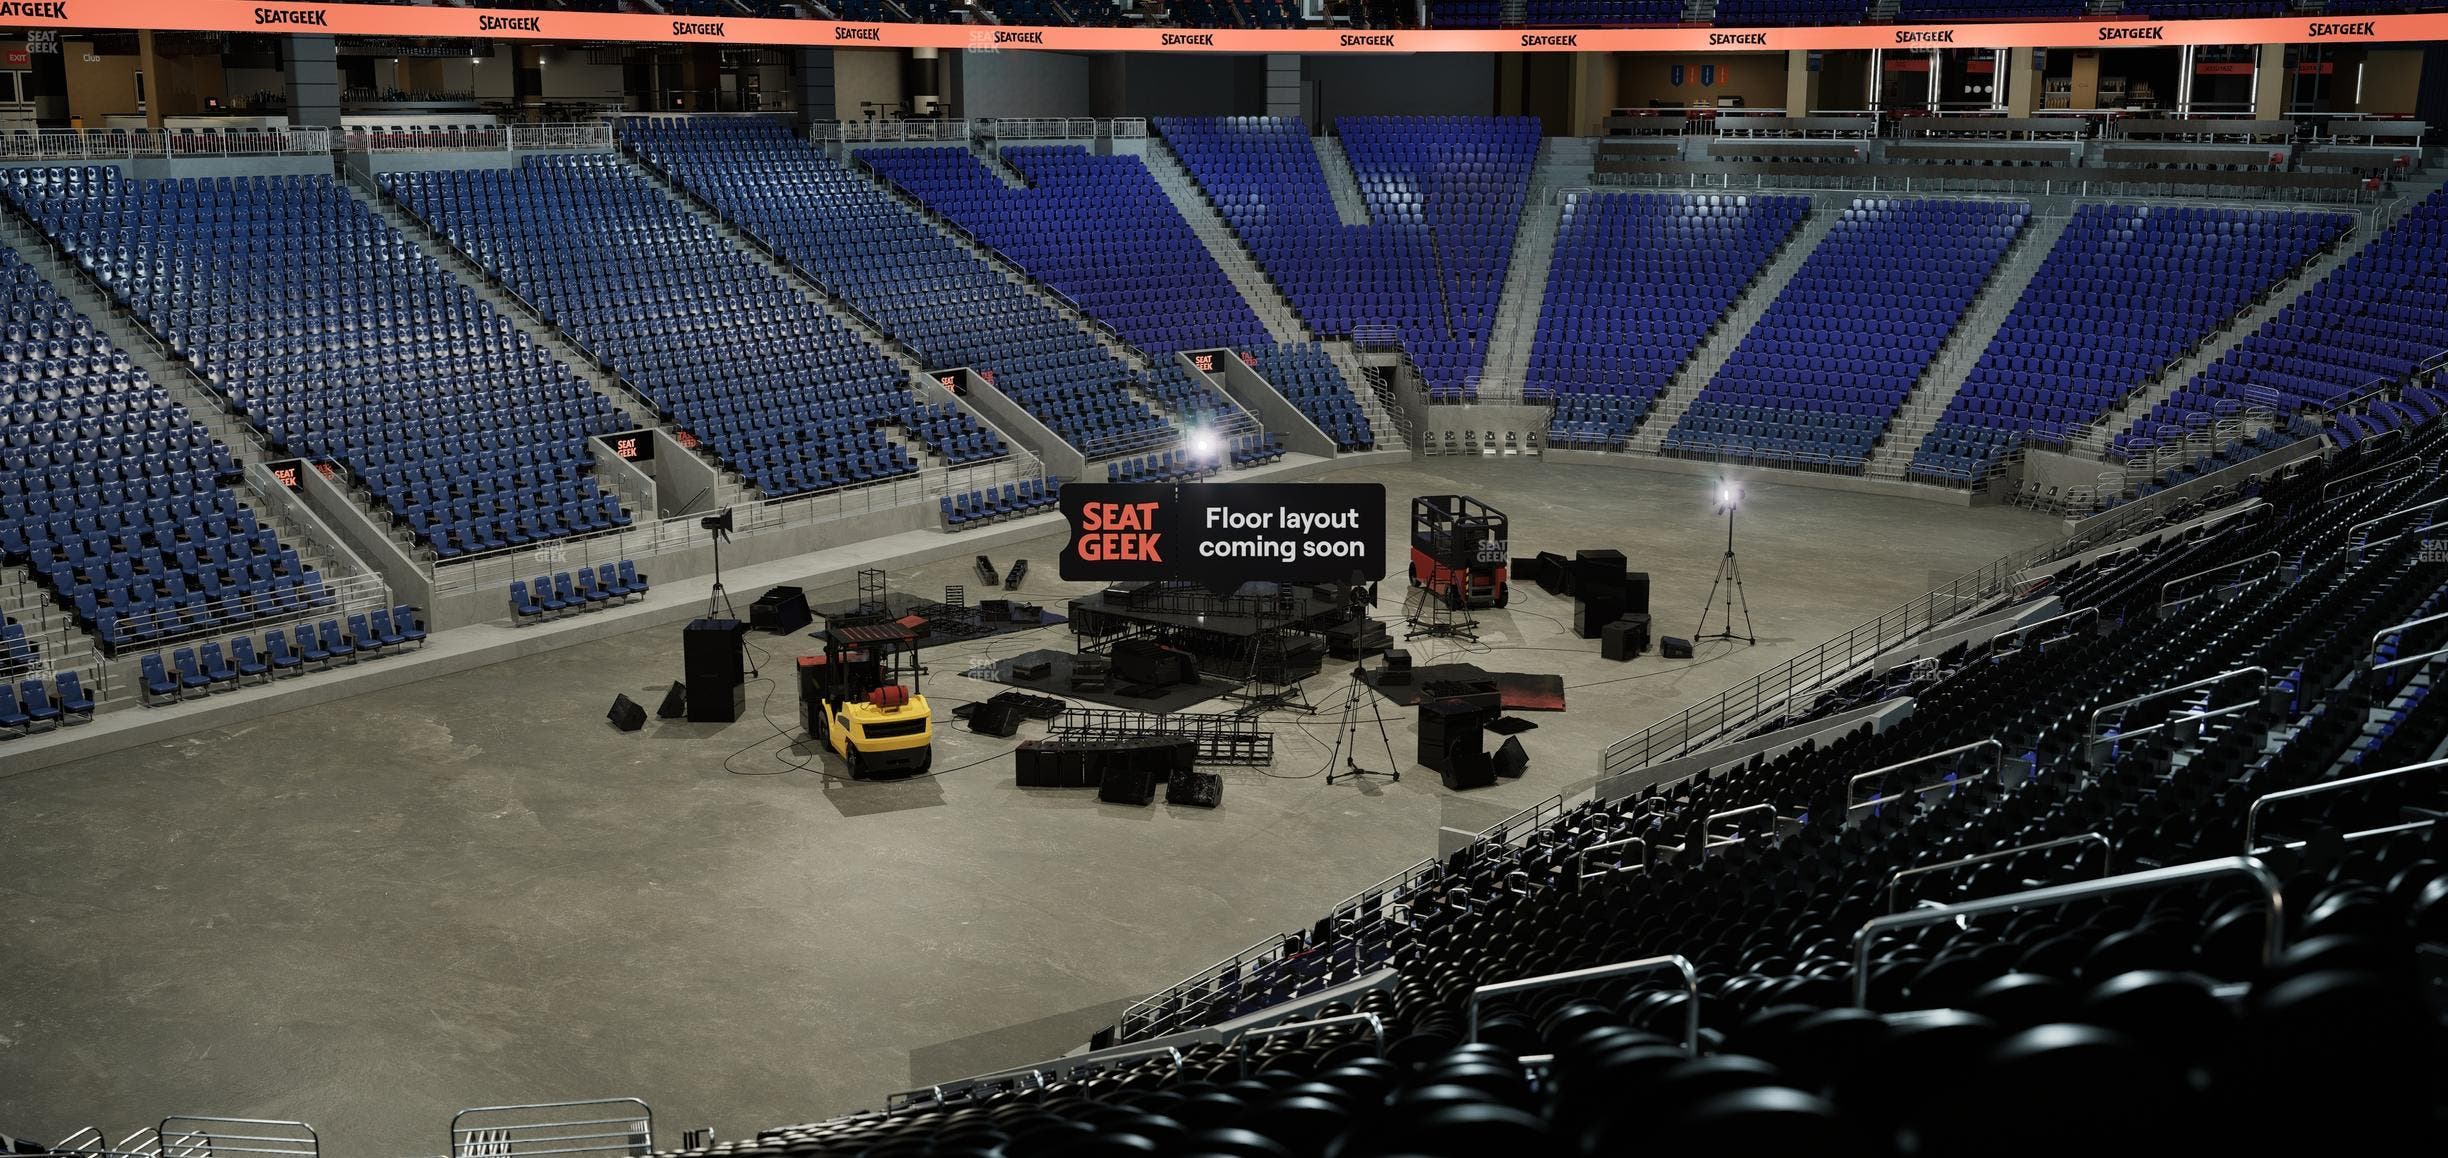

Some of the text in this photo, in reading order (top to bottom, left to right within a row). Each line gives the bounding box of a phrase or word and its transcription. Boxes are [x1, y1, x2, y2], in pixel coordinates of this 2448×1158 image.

[255, 8, 327, 27] SEATGEEK
[480, 14, 541, 32] SEATGEEK
[673, 21, 725, 37] SEATGEEK
[836, 26, 880, 41] SEATGEEK
[1896, 29, 1954, 43] SEATGEEK
[2099, 26, 2164, 41] SEATGEEK
[2309, 21, 2376, 37] SEATGEEK
[994, 31, 1043, 44] SEATGEEK
[1162, 33, 1214, 46] SEATGEEK
[1341, 34, 1395, 47] SEATGEEK
[1522, 34, 1577, 47] SEATGEEK
[1710, 33, 1767, 46] SEATGEEK
[83, 54, 101, 62] Club
[1195, 355, 1213, 364] SEAT
[617, 439, 636, 450] SEAT
[274, 468, 295, 479] SEAT
[280, 476, 297, 487] EEK
[1082, 501, 1159, 531] SEAT
[1206, 506, 1359, 534] Floor layout
[1078, 533, 1163, 563] GEEK
[1199, 535, 1365, 563] coming soon
